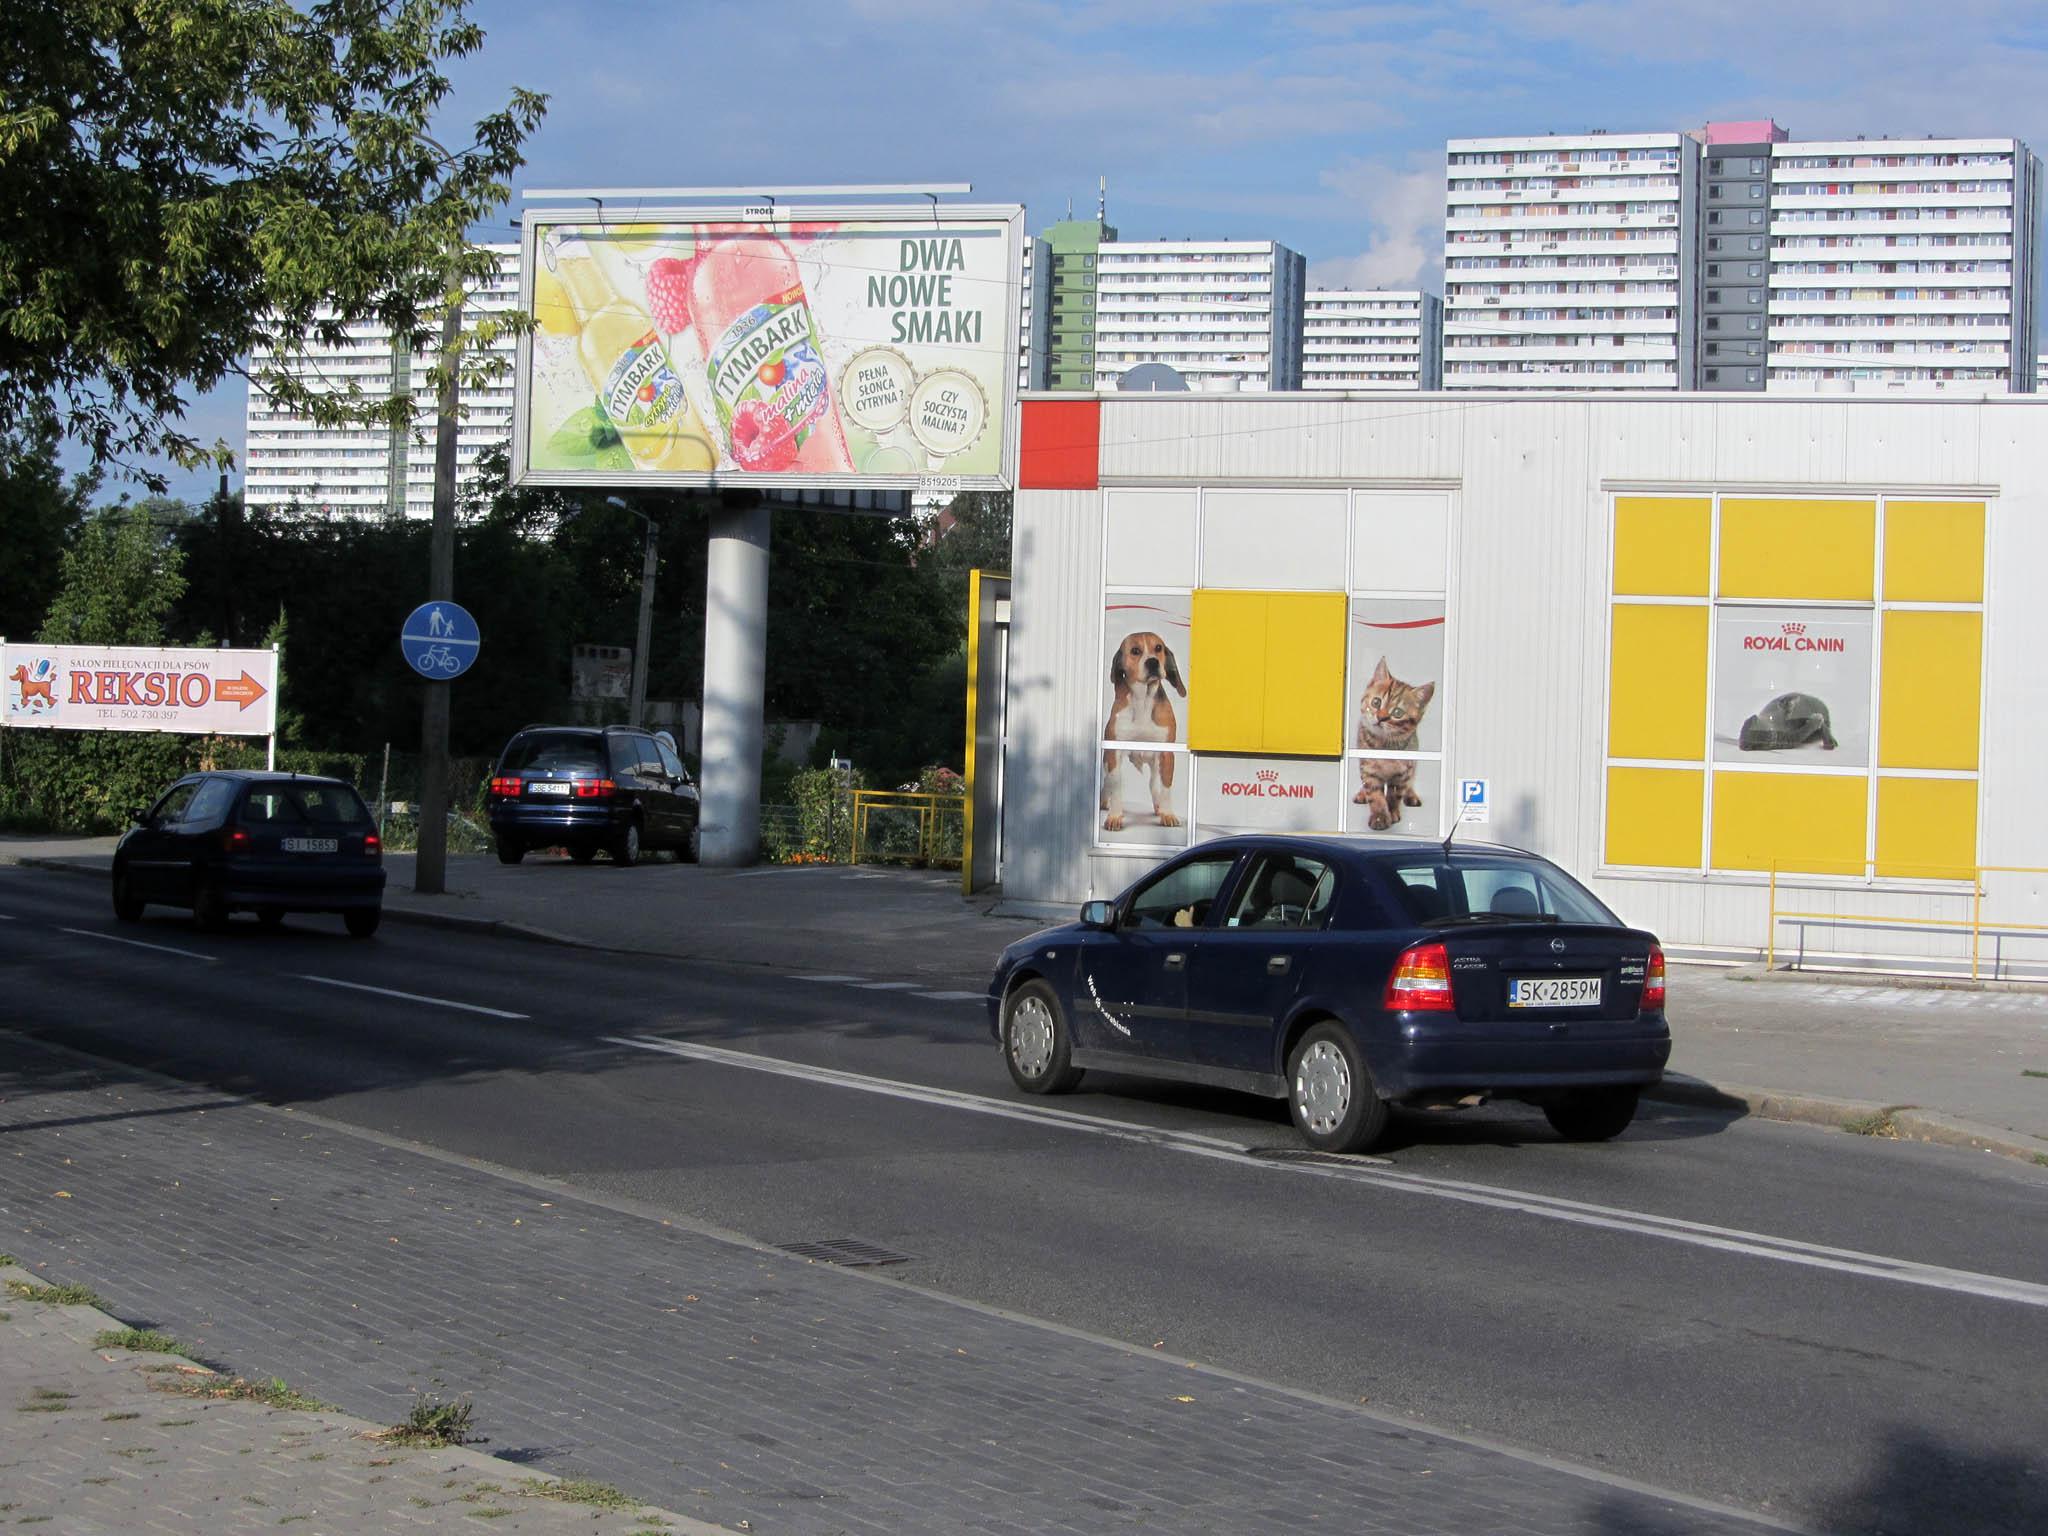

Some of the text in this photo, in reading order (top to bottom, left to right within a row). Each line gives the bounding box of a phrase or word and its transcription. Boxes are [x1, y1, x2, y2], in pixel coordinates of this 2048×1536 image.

[900, 239, 965, 272] DWA
[867, 275, 952, 308] NOWE
[732, 316, 756, 338] 1936
[890, 311, 982, 343] SMAKI
[718, 309, 806, 396] TYMBARK
[612, 346, 663, 415] TYMBARK
[858, 365, 888, 382] PEŁNA
[762, 368, 809, 423] malina
[856, 390, 904, 411] CYTRYNA ?
[941, 390, 959, 404] CZY
[923, 401, 968, 421] SOCZYSTA
[921, 415, 957, 434] MALINA
[921, 479, 957, 487] 8519205
[1743, 636, 1844, 652] ROYAL CANIN
[70, 660, 100, 668] SALON
[103, 660, 160, 670] PIELĘGNACJI
[183, 660, 210, 670] PSÓW
[68, 671, 211, 708] REKSIO
[121, 710, 138, 719] 502
[141, 710, 158, 719] 730
[161, 711, 179, 719] 397
[1222, 783, 1314, 798] ROYAL CANIN
[1465, 783, 1481, 801] P
[1520, 980, 1599, 1001] SK 2859M
